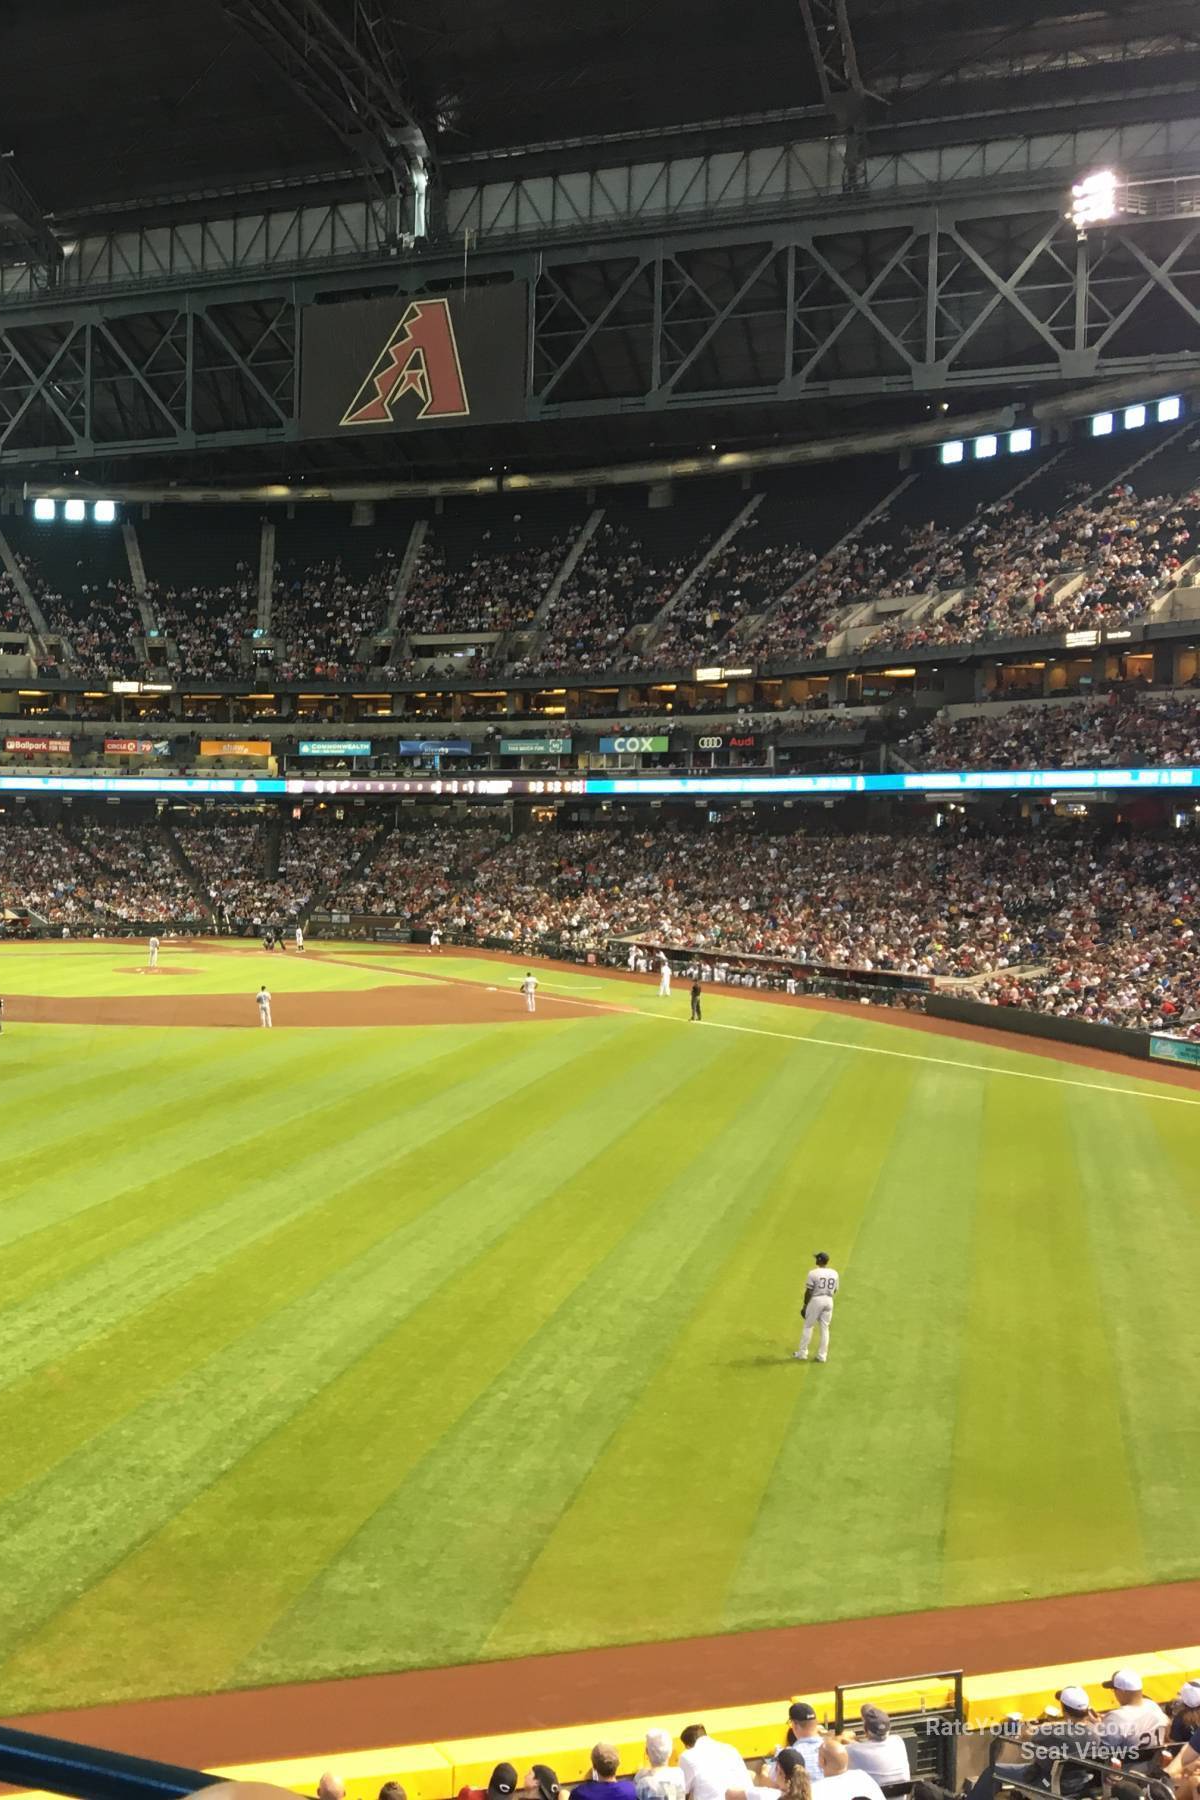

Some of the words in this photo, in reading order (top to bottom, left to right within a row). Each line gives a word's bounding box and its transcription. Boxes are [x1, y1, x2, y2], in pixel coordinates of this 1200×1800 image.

[15, 740, 47, 751] Ballpark
[614, 737, 654, 752] COX
[729, 736, 754, 746] Audi
[311, 743, 370, 751] COMMONWEALTH
[819, 1277, 835, 1289] 38
[1138, 1729, 1162, 1749] 21
